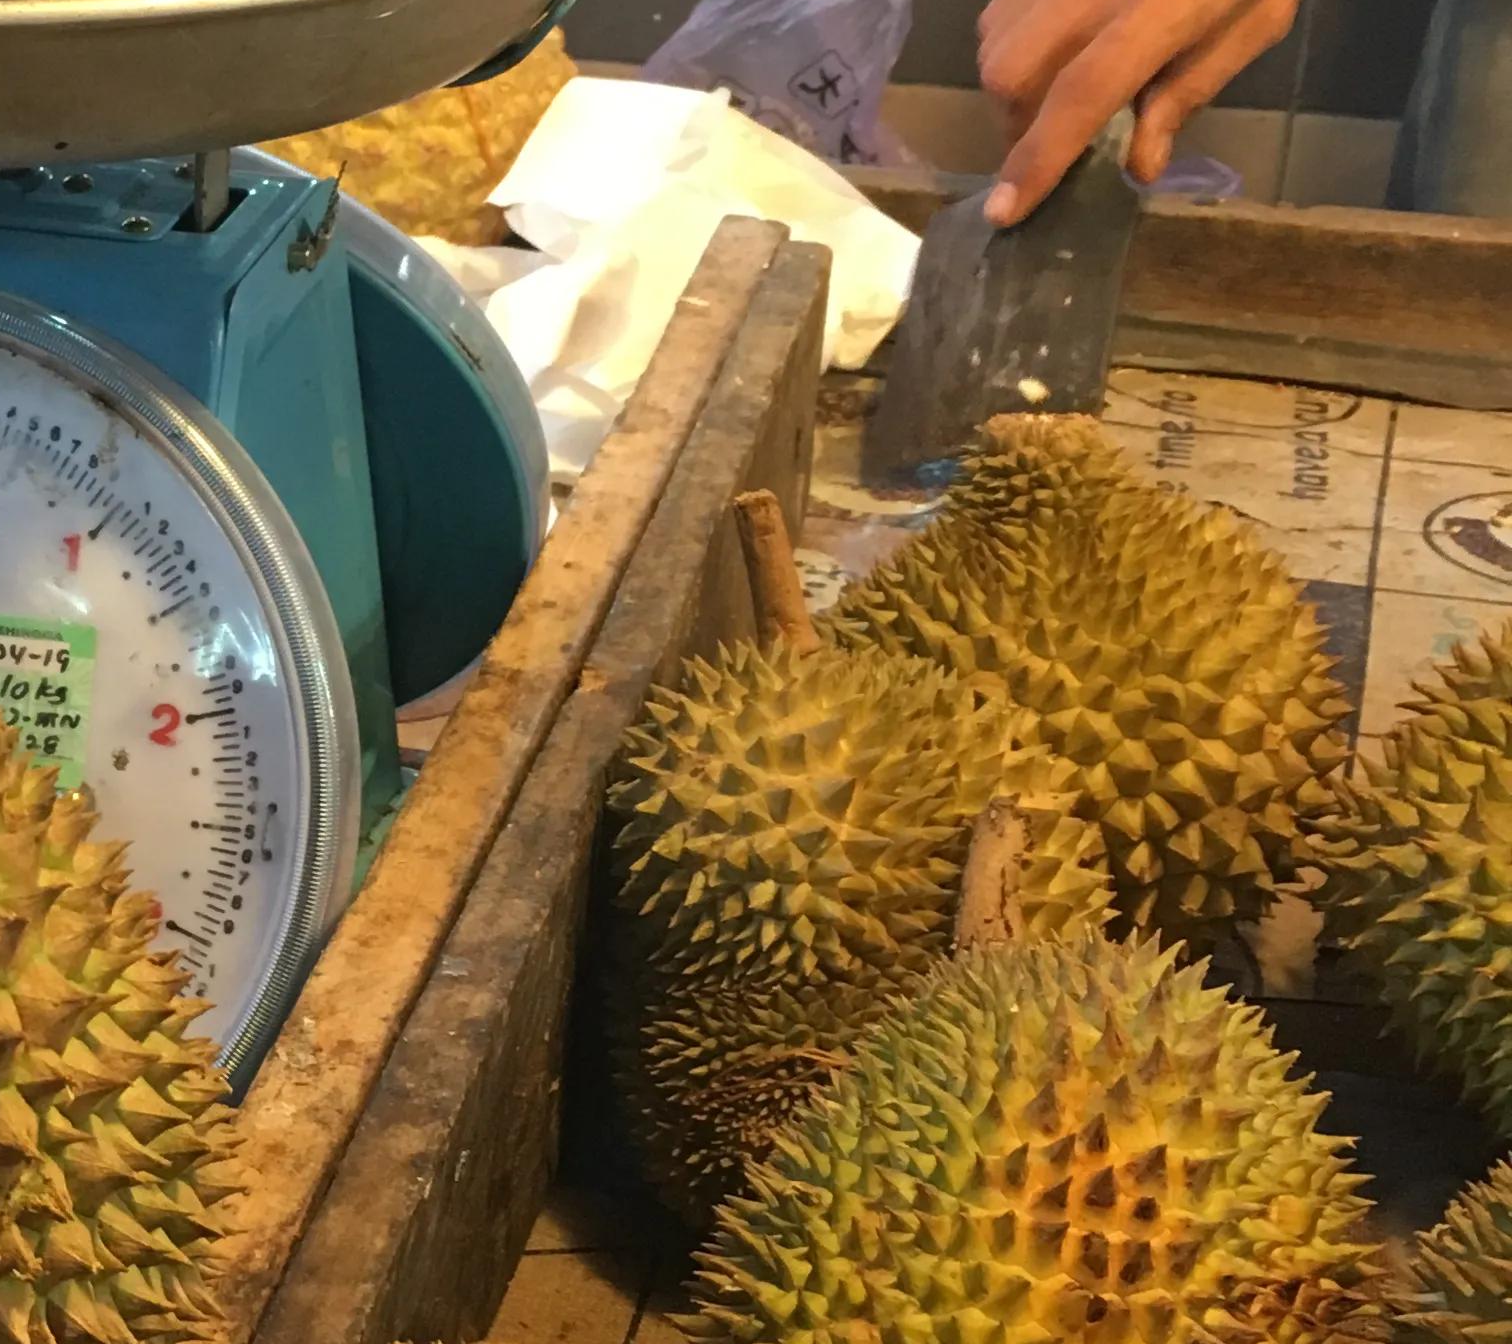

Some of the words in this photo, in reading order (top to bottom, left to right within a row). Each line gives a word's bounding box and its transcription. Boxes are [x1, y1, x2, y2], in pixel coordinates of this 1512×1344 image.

[70, 439, 82, 454] 7
[1276, 446, 1330, 500] have
[158, 519, 169, 536] 2
[61, 533, 82, 573] 1
[149, 703, 181, 747] 2
[245, 751, 258, 767] 2
